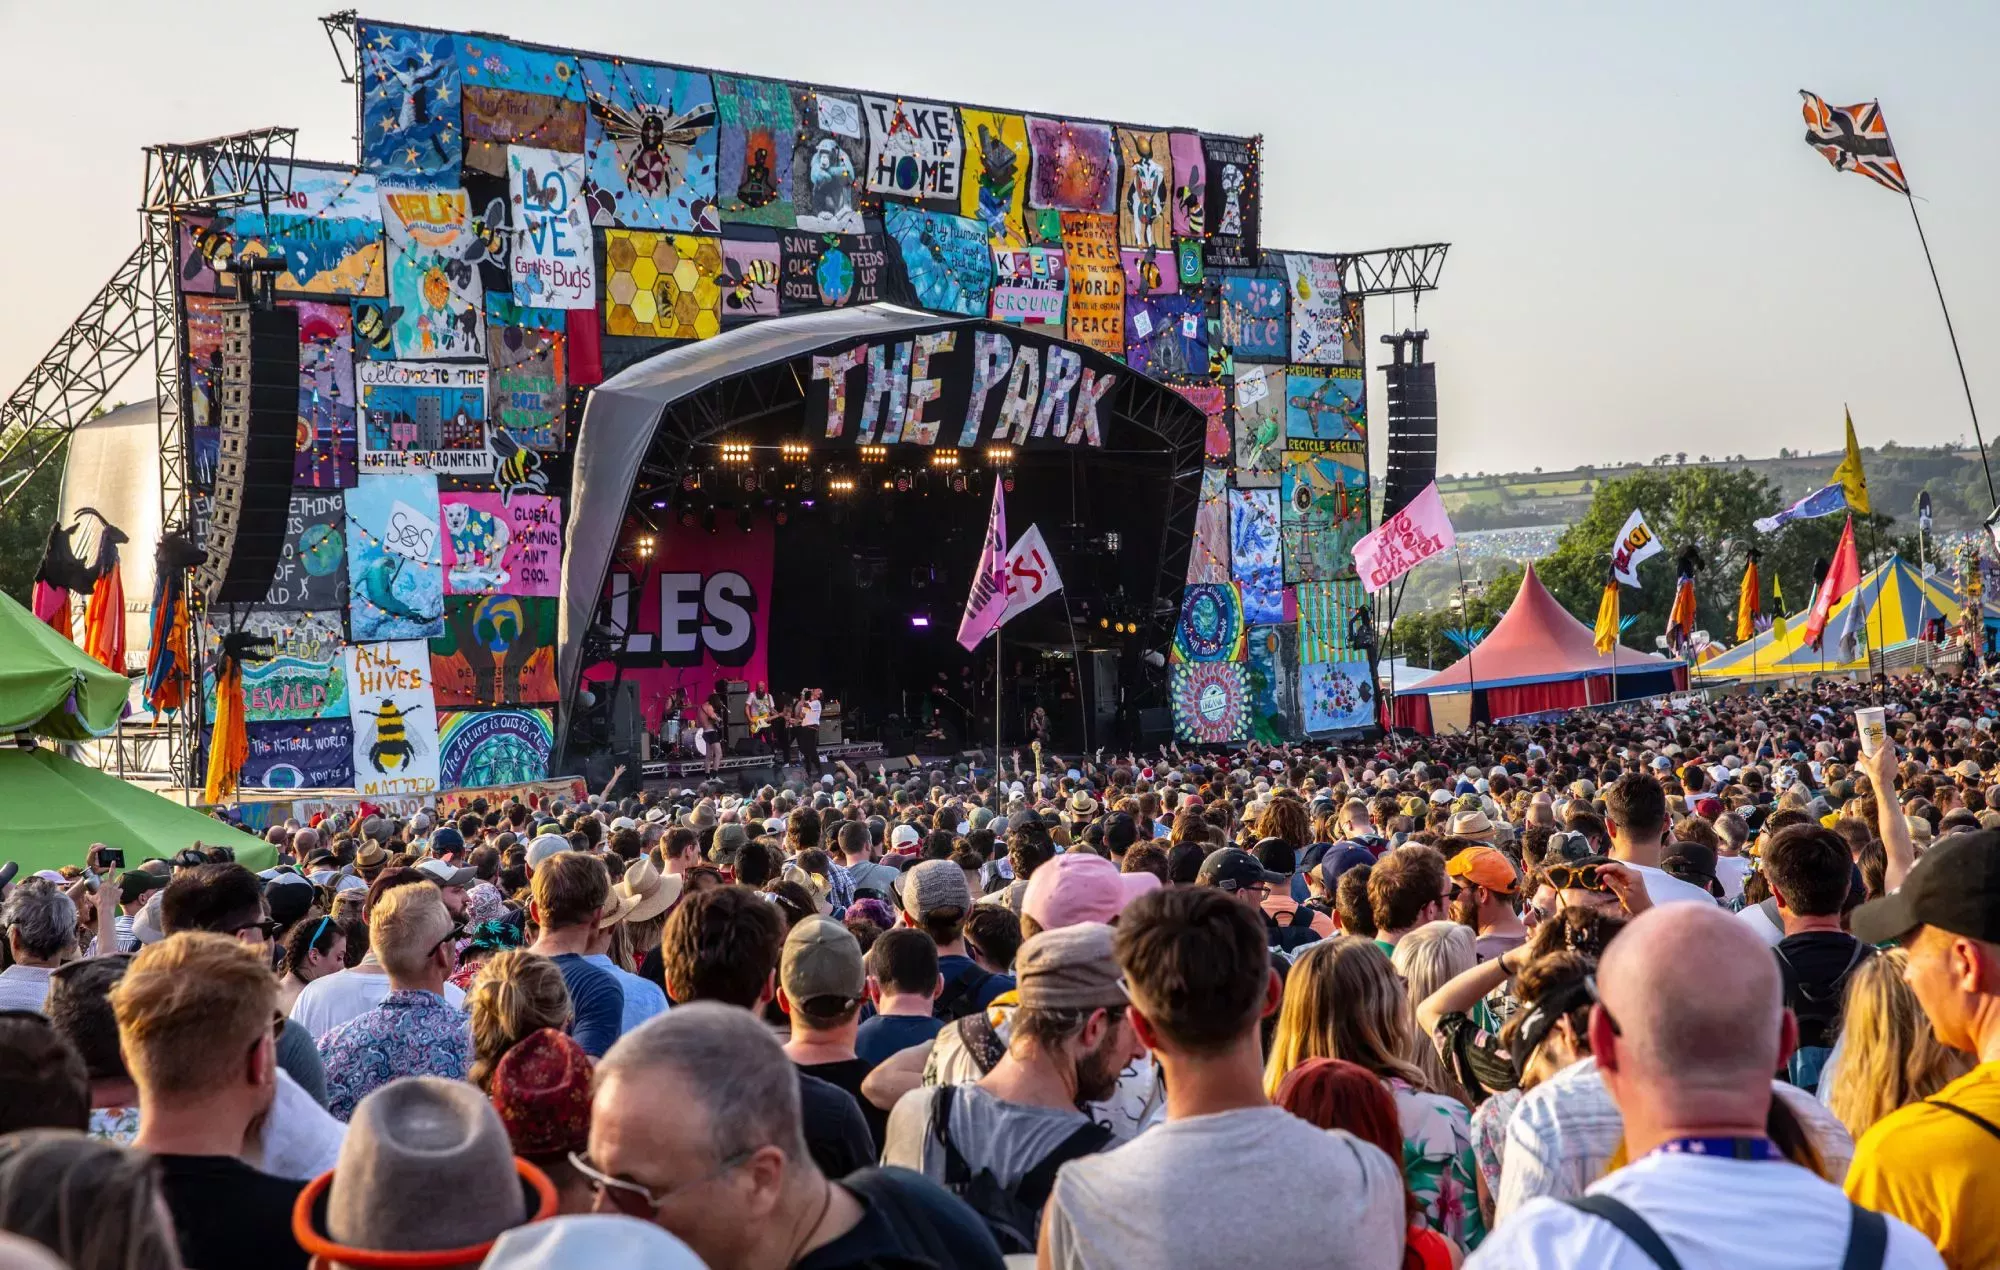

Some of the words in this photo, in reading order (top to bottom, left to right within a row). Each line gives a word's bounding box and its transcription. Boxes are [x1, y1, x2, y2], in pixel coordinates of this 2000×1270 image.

[871, 103, 953, 141] TAKE
[932, 142, 947, 156] IT
[286, 191, 308, 209] NO
[270, 214, 332, 241] PLASTIC
[785, 236, 818, 254] SAVE
[856, 235, 873, 249] IT
[1066, 241, 1116, 260] PEACE
[788, 259, 813, 276] OUR
[849, 250, 884, 267] FEEDS
[516, 255, 552, 276] Earth's
[553, 260, 591, 300] Bugs
[861, 268, 877, 285] US
[1002, 276, 1016, 288] IT
[1020, 277, 1034, 289] IN
[1037, 279, 1058, 292] THE
[785, 281, 818, 299] SOIL
[857, 286, 879, 301] ALL
[1072, 278, 1120, 296] WORLD
[995, 293, 1060, 313] GROUND
[1071, 316, 1120, 333] PEACE
[1222, 301, 1279, 347] Nice
[360, 360, 431, 384] Welcome
[432, 368, 449, 385] TO
[459, 369, 485, 385] THE
[1288, 365, 1326, 378] REDUCE
[1332, 367, 1363, 380] REUSE
[812, 331, 957, 446] THE
[958, 331, 1116, 447] PARK
[511, 392, 544, 411] SOIL
[1288, 439, 1326, 452] RECYCLE
[1330, 441, 1366, 454] RECLAIM
[364, 452, 408, 468] HOSTILE
[414, 451, 488, 468] ENVIRONMENT
[514, 506, 557, 524] GLOBAL
[512, 529, 558, 546] WARMING
[521, 567, 550, 584] COOL
[355, 642, 401, 673] ALL
[359, 667, 423, 696] HIVES
[240, 683, 327, 713] REWILD
[273, 738, 313, 754] NATURAL
[315, 735, 348, 752] WORLD
[442, 750, 461, 779] The
[457, 723, 489, 757] future
[490, 716, 500, 730] is
[501, 716, 519, 729] ours
[519, 718, 531, 733] to
[310, 767, 341, 786] YOU'RE
[344, 767, 350, 778] A
[364, 777, 436, 796] MATTER
